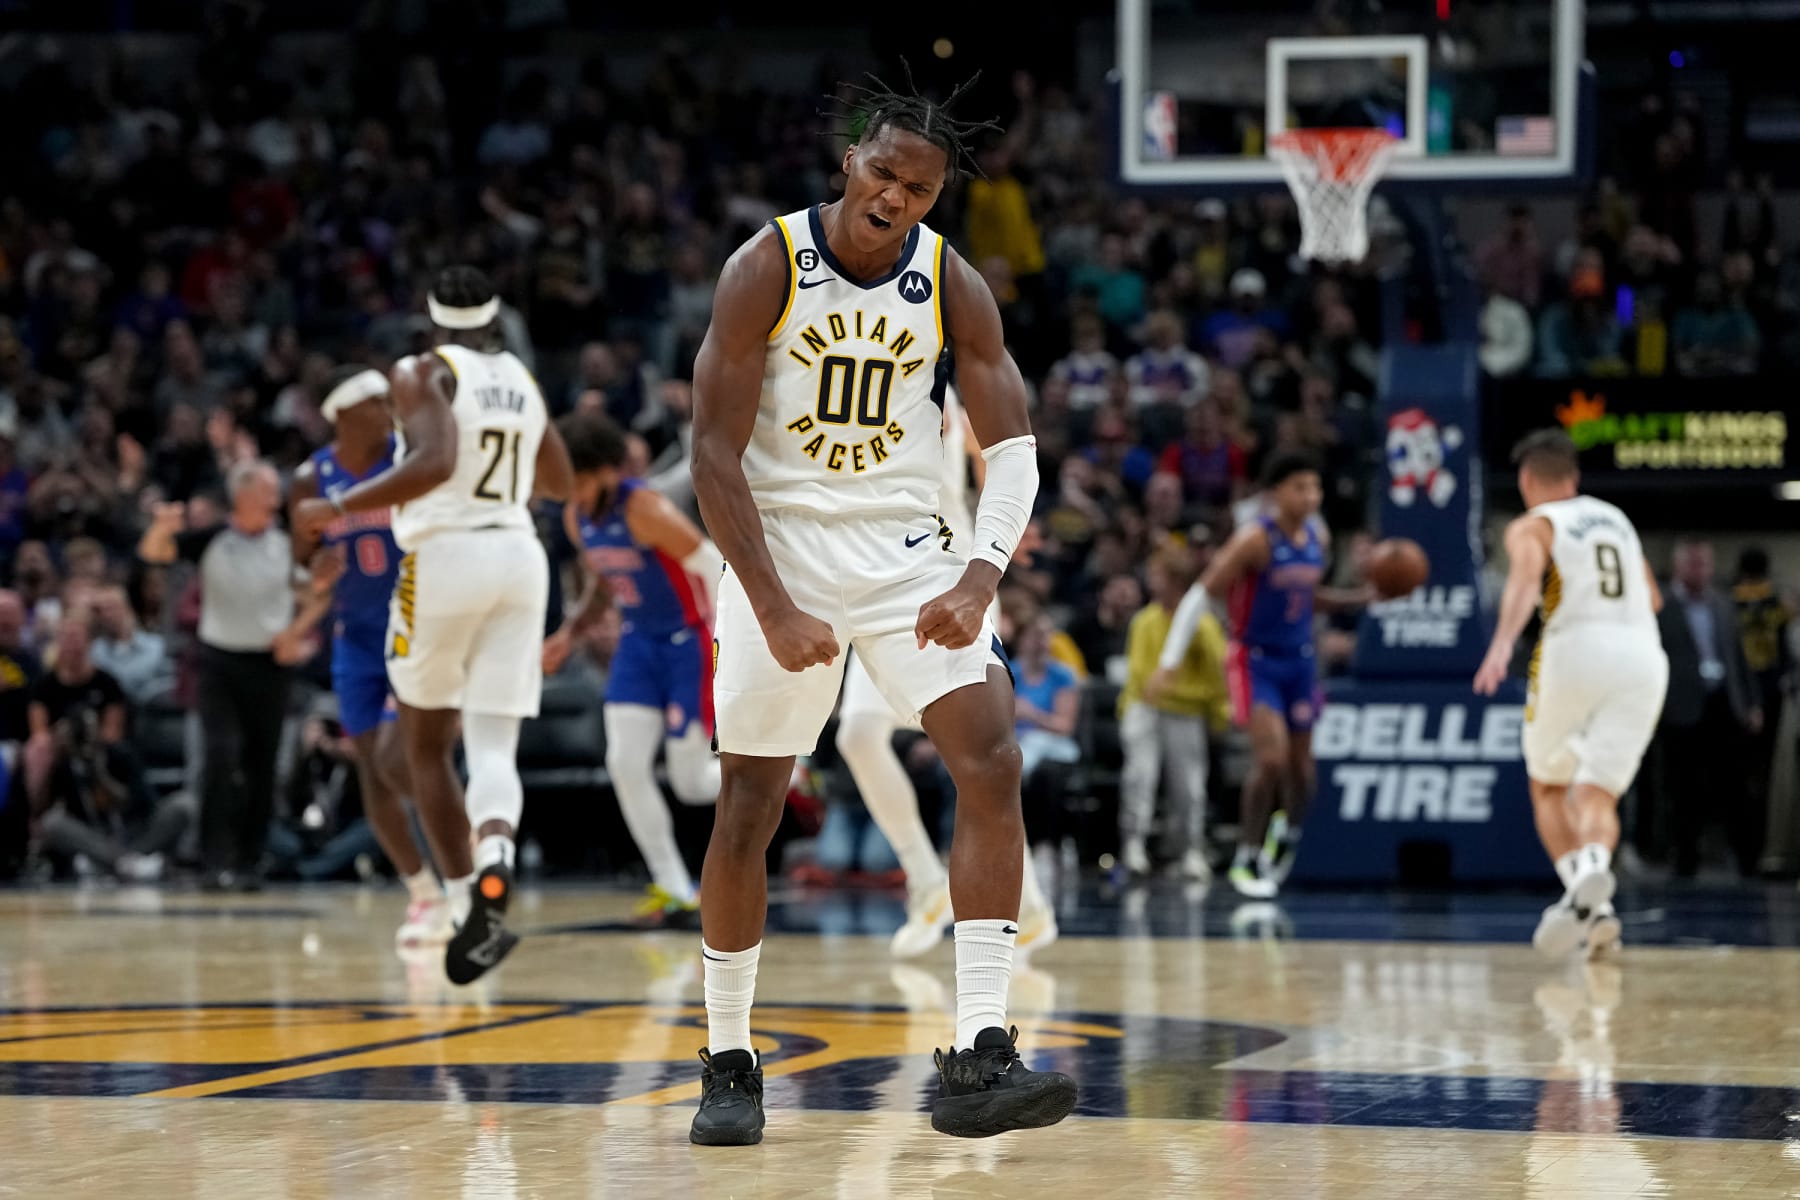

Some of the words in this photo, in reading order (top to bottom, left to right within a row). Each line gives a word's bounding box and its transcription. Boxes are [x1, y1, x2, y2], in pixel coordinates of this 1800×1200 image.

[800, 252, 814, 269] 6
[789, 310, 925, 378] INDIANA
[815, 354, 895, 427] 00
[473, 428, 522, 504] 21
[786, 414, 904, 473] PACERS
[1594, 543, 1624, 599] 9
[1367, 584, 1474, 619] LLE
[1380, 619, 1460, 648] TIRE
[1311, 703, 1524, 761] BELLE
[1332, 764, 1497, 821] TIRE
